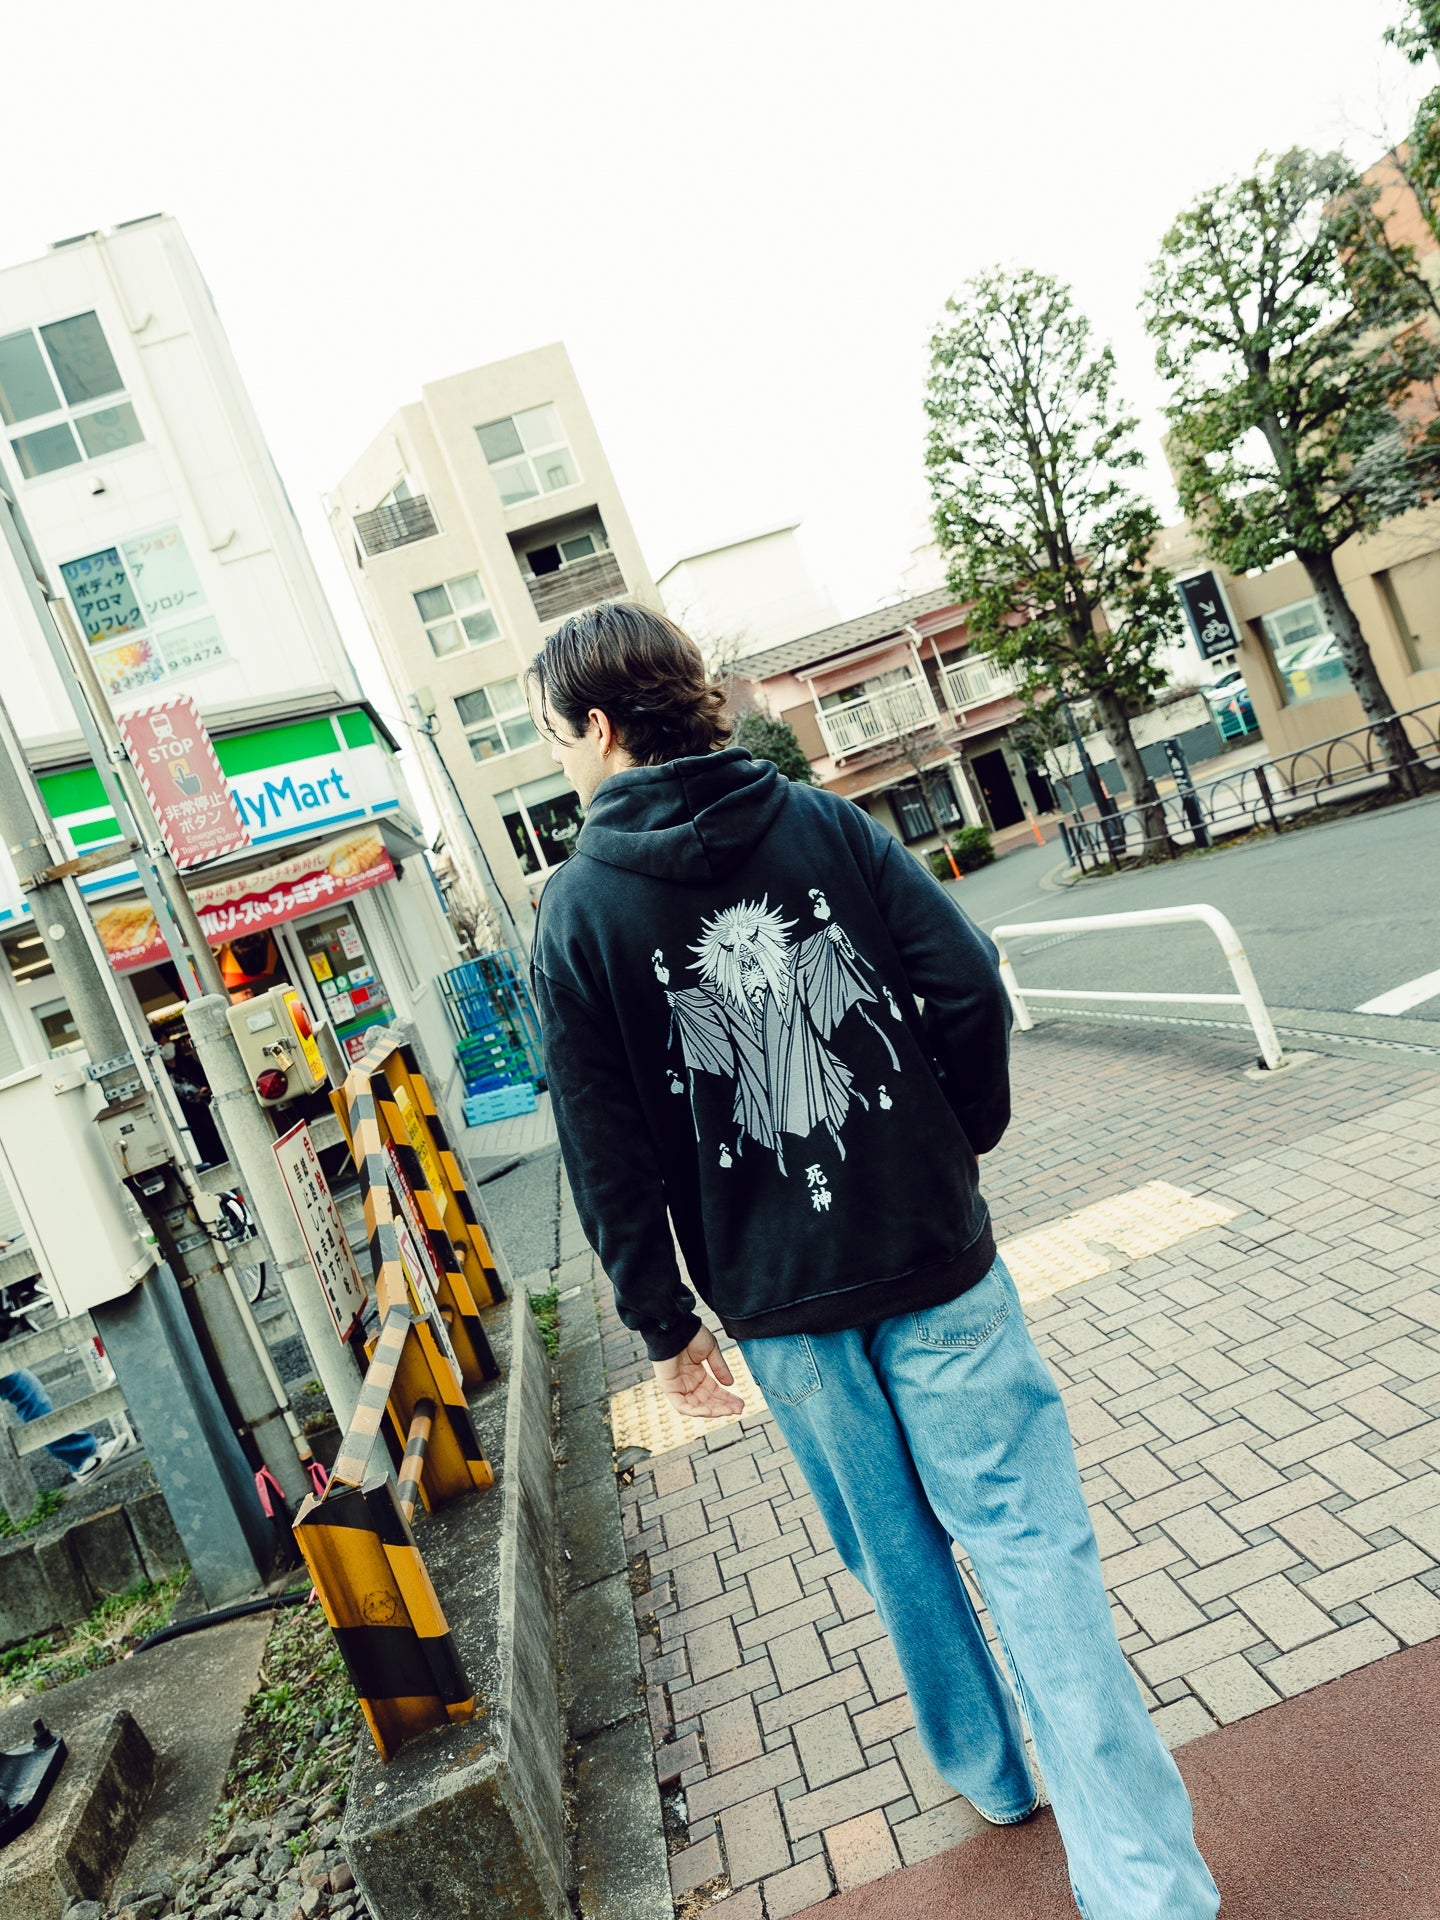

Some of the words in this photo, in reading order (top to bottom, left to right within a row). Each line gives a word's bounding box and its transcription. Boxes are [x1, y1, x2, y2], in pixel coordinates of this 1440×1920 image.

[75, 563, 145, 598] ボディケア
[81, 593, 122, 617] アロマ
[88, 590, 199, 634] リフレクソロジー
[147, 737, 194, 763] STOP
[164, 791, 226, 822] 非常停止
[231, 767, 351, 828] lyMart
[179, 809, 222, 834] ボタン
[186, 826, 226, 844] Emergency
[181, 843, 200, 856] Train
[200, 838, 217, 850] Stop
[216, 831, 240, 844] Button
[805, 1164, 832, 1212] 死神
